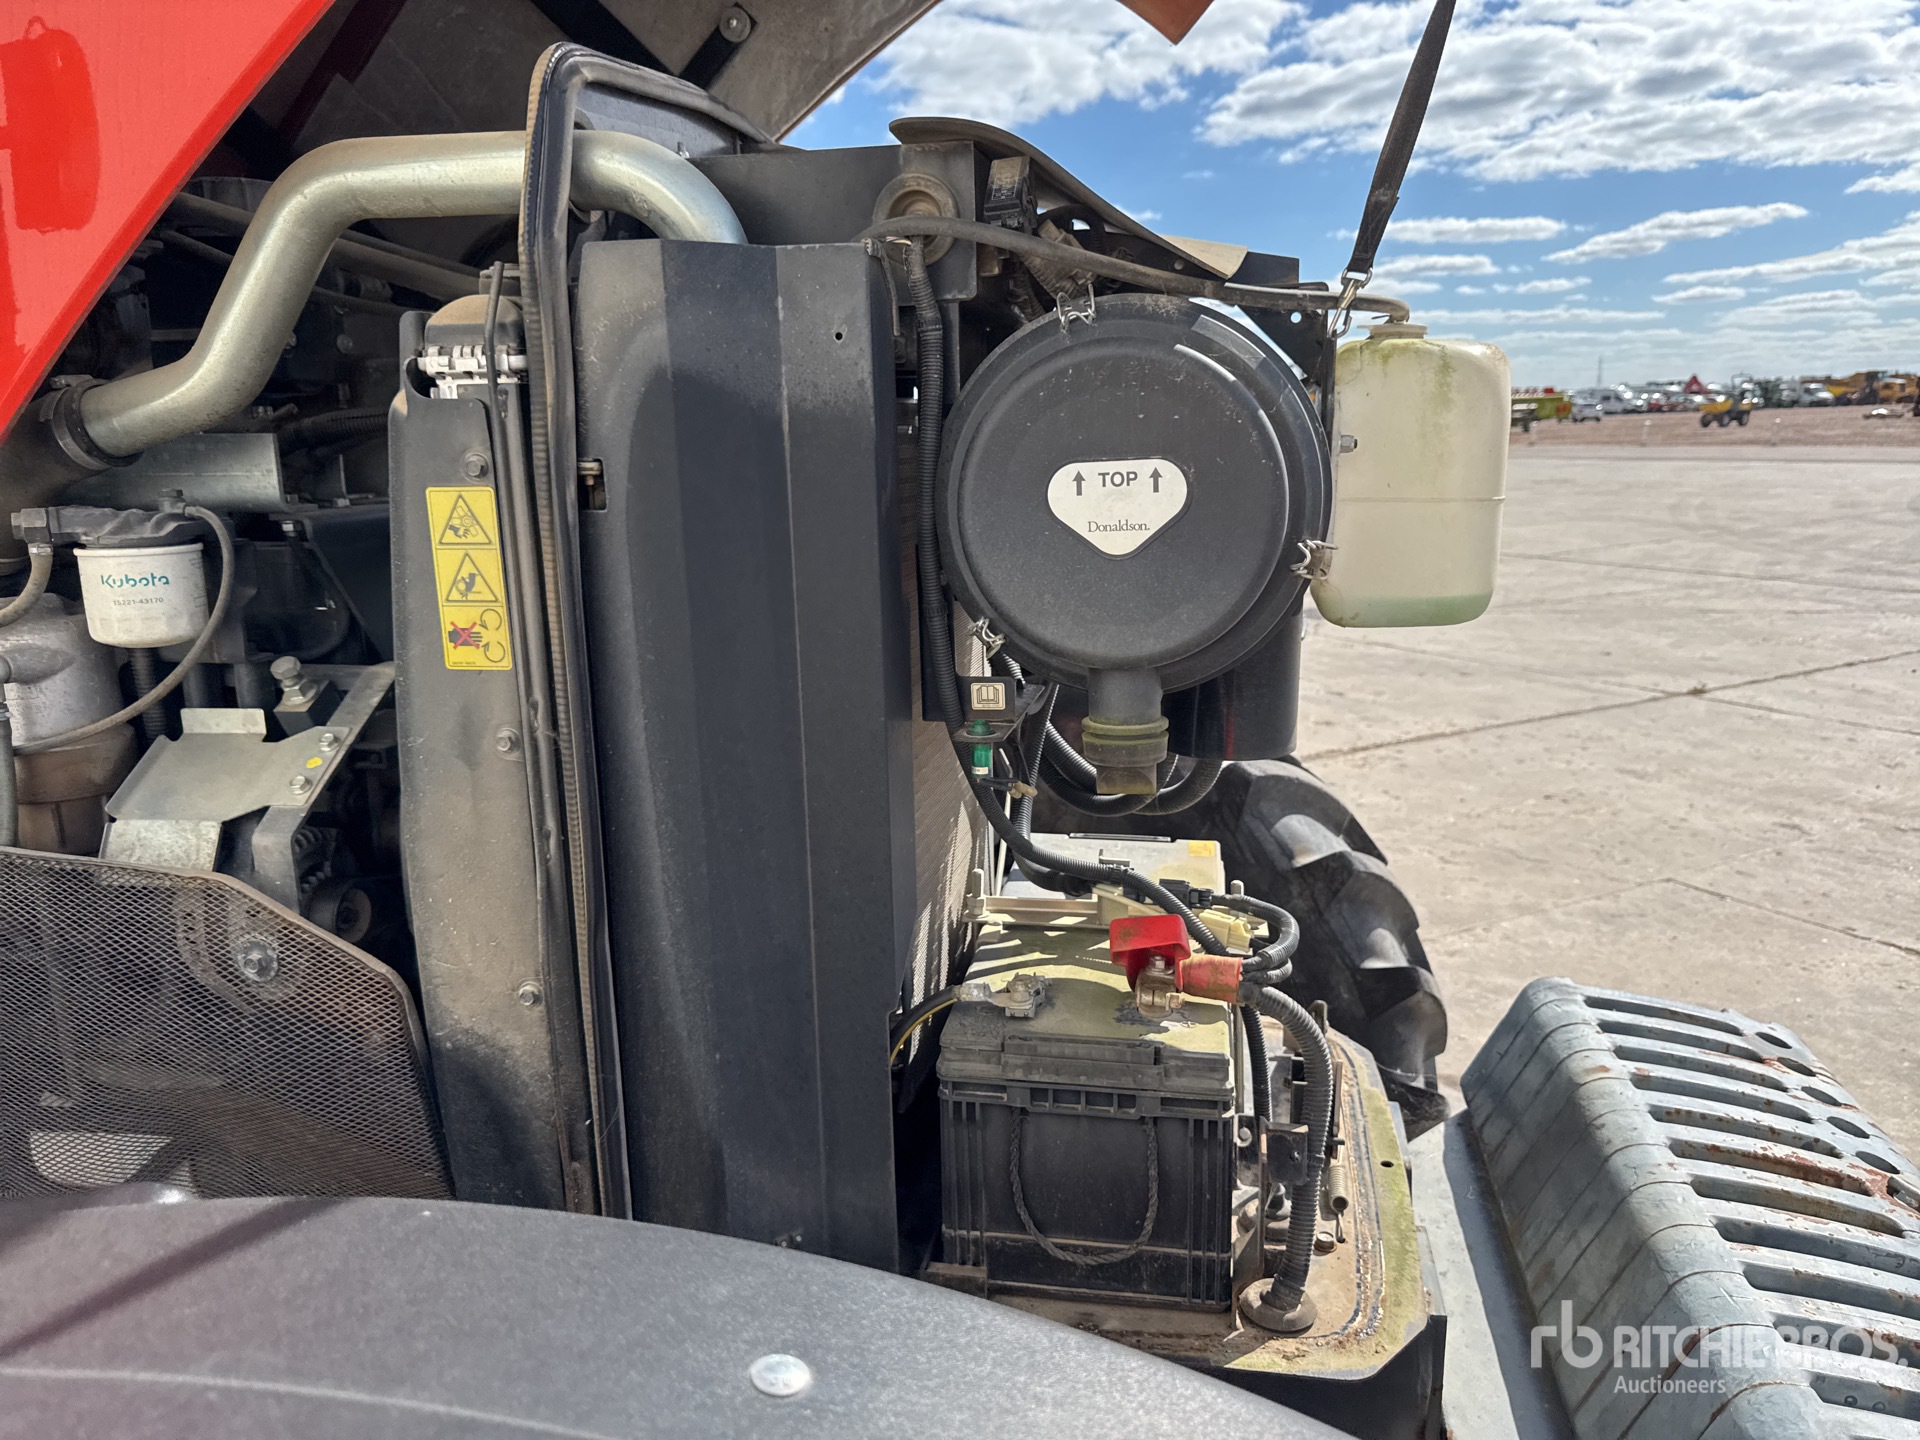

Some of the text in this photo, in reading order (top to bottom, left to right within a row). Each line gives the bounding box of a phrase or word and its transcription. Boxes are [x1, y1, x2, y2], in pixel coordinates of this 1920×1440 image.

[1098, 471, 1138, 488] TOP
[100, 572, 170, 588] Kubota
[112, 597, 164, 606] 15221-43170
